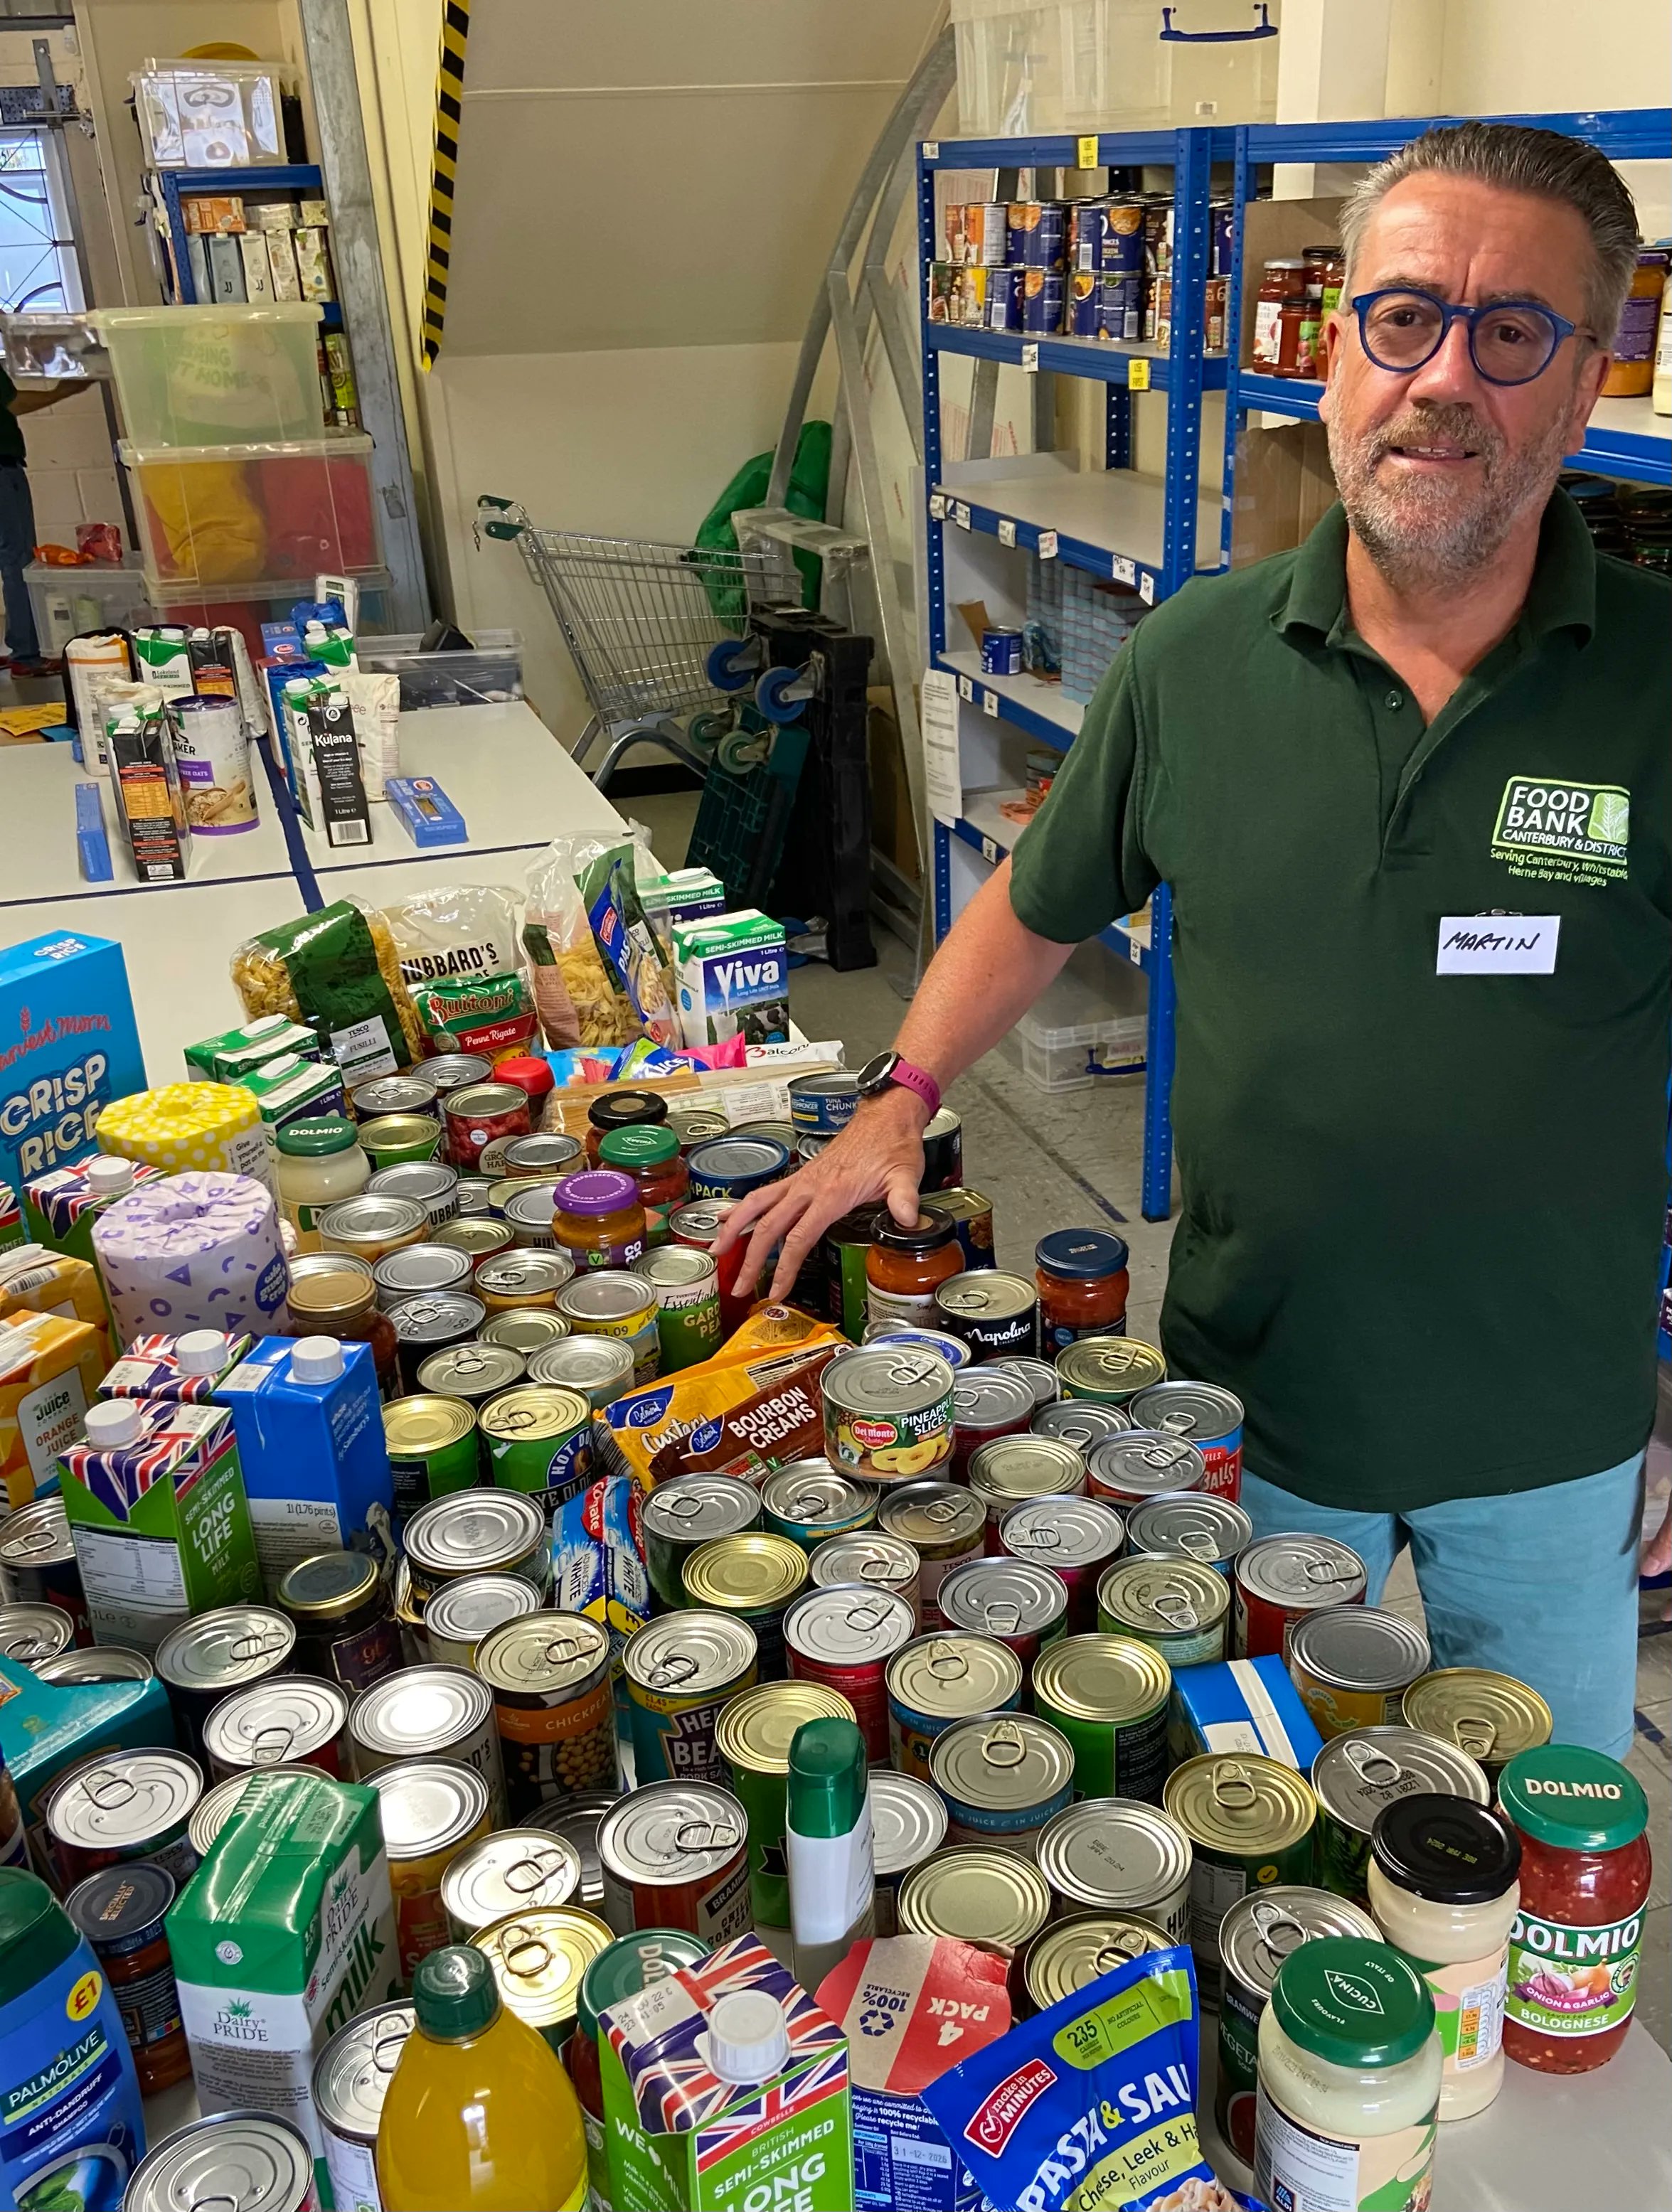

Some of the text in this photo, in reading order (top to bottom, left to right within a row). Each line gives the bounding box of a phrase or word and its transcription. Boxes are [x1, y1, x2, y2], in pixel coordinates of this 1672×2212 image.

[173, 743, 196, 756] AKER
[1512, 786, 1590, 813] FOOD
[1506, 805, 1587, 836] BANK
[1502, 829, 1575, 849] CANTERBURY
[1575, 839, 1584, 850] &
[1490, 848, 1525, 865] Serving
[1526, 853, 1580, 872] Canterbury,
[1508, 865, 1607, 887] Herne Bay and villages
[702, 888, 720, 897] MILK
[33, 938, 76, 957] CRISP
[52, 942, 87, 960] RICE
[705, 932, 783, 954] SEMI-SKIMMED MILK
[1442, 931, 1540, 951] MARTIN
[713, 960, 779, 995] Viva
[428, 988, 514, 1025] Buitoni
[348, 1024, 369, 1036] TESCO
[464, 1027, 516, 1047] Penne Rigate
[0, 1018, 57, 1072] arvest
[350, 1037, 377, 1053] FUSILLI
[745, 1042, 810, 1058] Balconi
[1, 1053, 107, 1137] CRISP
[825, 1102, 857, 1111] CHUNK
[21, 1099, 101, 1180] RICE
[288, 1126, 344, 1136] DOLMIO
[236, 1140, 250, 1151] Give
[683, 1301, 720, 1327] GARD
[699, 1320, 721, 1339] PEA
[964, 1320, 1031, 1346] Napolina
[36, 1391, 70, 1421] Juice
[728, 1386, 809, 1438] BOURBON
[900, 1394, 953, 1428] PINEAPPLE
[36, 1412, 80, 1447] ORANGE
[749, 1404, 817, 1448] CREAMS
[854, 1426, 895, 1438] Del Monte
[915, 1411, 947, 1436] SLICES
[46, 1428, 78, 1457] JUICE
[550, 1442, 577, 1475] HOT
[185, 1467, 235, 1525] SEMI-SKIMMED
[192, 1492, 235, 1549] LONG
[200, 1517, 233, 1563] LIFE
[212, 1551, 231, 1576] MILK
[623, 1554, 636, 1598] WHITE
[942, 1556, 974, 1572] TESCO
[570, 1556, 583, 1601] WHITE
[1524, 1778, 1622, 1800] DOLMIO
[1104, 1855, 1126, 1872] 2024
[99, 1880, 127, 1921] SPECIALLY
[108, 1885, 136, 1923] SELECTED
[321, 1899, 370, 1992] Semi-skimmed
[1364, 1960, 1396, 1983] OF ITALY
[74, 1979, 97, 2014] £1
[863, 1991, 907, 2012] 100%
[866, 1984, 911, 1998] RECYCLABLE
[1333, 1975, 1378, 2010] CUCINA
[1525, 1986, 1611, 2011] ONION & GARLIC
[217, 2010, 260, 2032] Dairy
[927, 1997, 990, 2022] PACK
[1225, 1994, 1260, 2025] BRAMWE
[1311, 1998, 1346, 2025] FLAVOURS
[1520, 2007, 1610, 2030] BOLOGNESE
[213, 2021, 269, 2043] PRIDE
[937, 2021, 964, 2046] 4
[1067, 2019, 1097, 2049] 235
[9, 2030, 100, 2108] PALMOLIVE
[28, 2073, 103, 2137] ANTI-DANDRUFF
[992, 2074, 1028, 2114] make in
[1001, 2068, 1052, 2125] MINUTES
[52, 2100, 89, 2132] SHAMPOO
[750, 2105, 796, 2135] COWBELLE
[878, 2117, 905, 2130] recycle
[905, 2122, 921, 2132] me!
[879, 2107, 901, 2118] 100%
[615, 2117, 646, 2156] WE
[751, 2126, 795, 2159] BRITISH
[1016, 2105, 1109, 2212] PASTA
[1100, 2100, 1125, 2130] &
[1118, 2063, 1192, 2124] SAU
[714, 2118, 835, 2200] SEMI-SKIMMED
[1123, 2131, 1181, 2171] Leek &
[1129, 2159, 1171, 2191] Flavour
